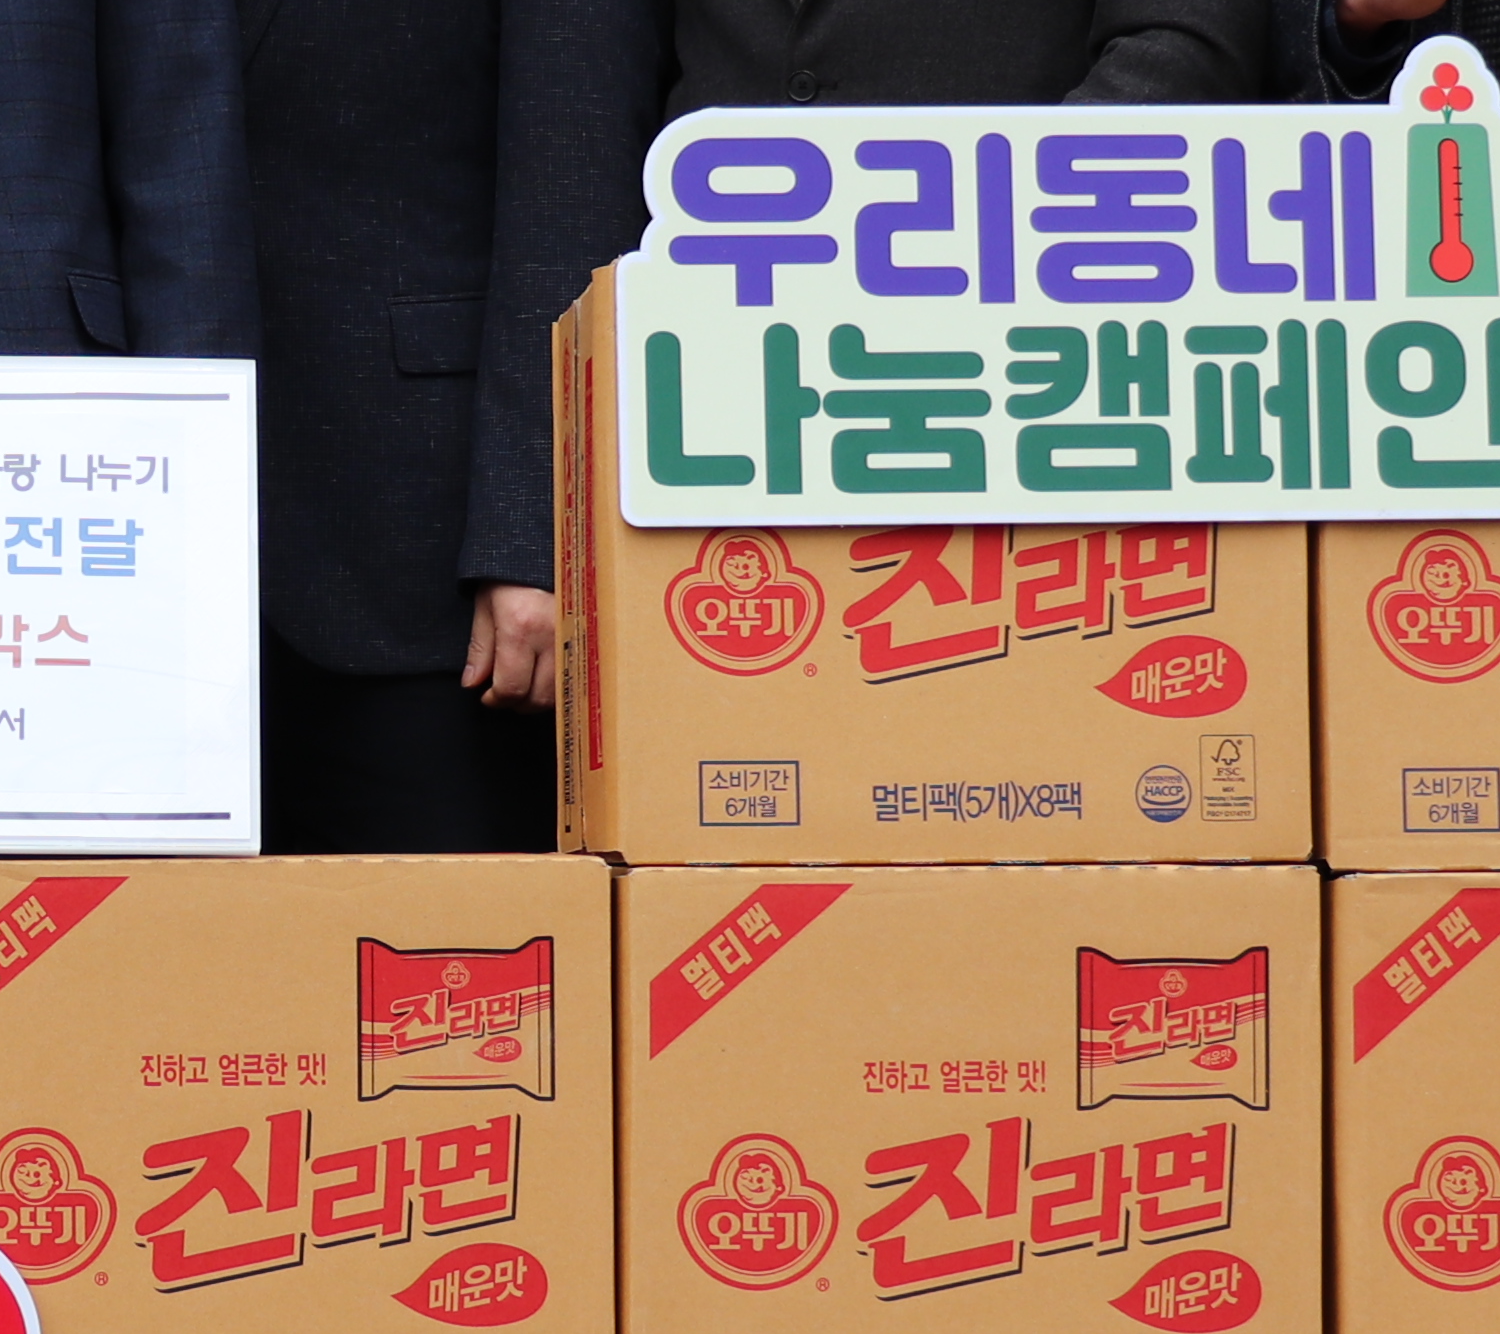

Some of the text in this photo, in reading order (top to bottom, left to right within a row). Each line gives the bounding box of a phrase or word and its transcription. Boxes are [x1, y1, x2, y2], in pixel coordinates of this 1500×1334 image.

[669, 130, 1377, 308] 우리동네
[59, 453, 171, 494] 나누기
[3, 515, 144, 578] 전달
[842, 523, 1220, 686] 진라면
[1131, 648, 1228, 705] 매운맛
[709, 770, 789, 792] 소비기간
[726, 796, 777, 818] 6개월
[681, 902, 783, 1000] 멀티팩
[390, 991, 522, 1053] 진라면
[134, 1109, 521, 1294] 진라면
[856, 1116, 1236, 1301] 진라면
[429, 1256, 528, 1313] 매운맛
[1145, 1263, 1242, 1320] 매운맛
